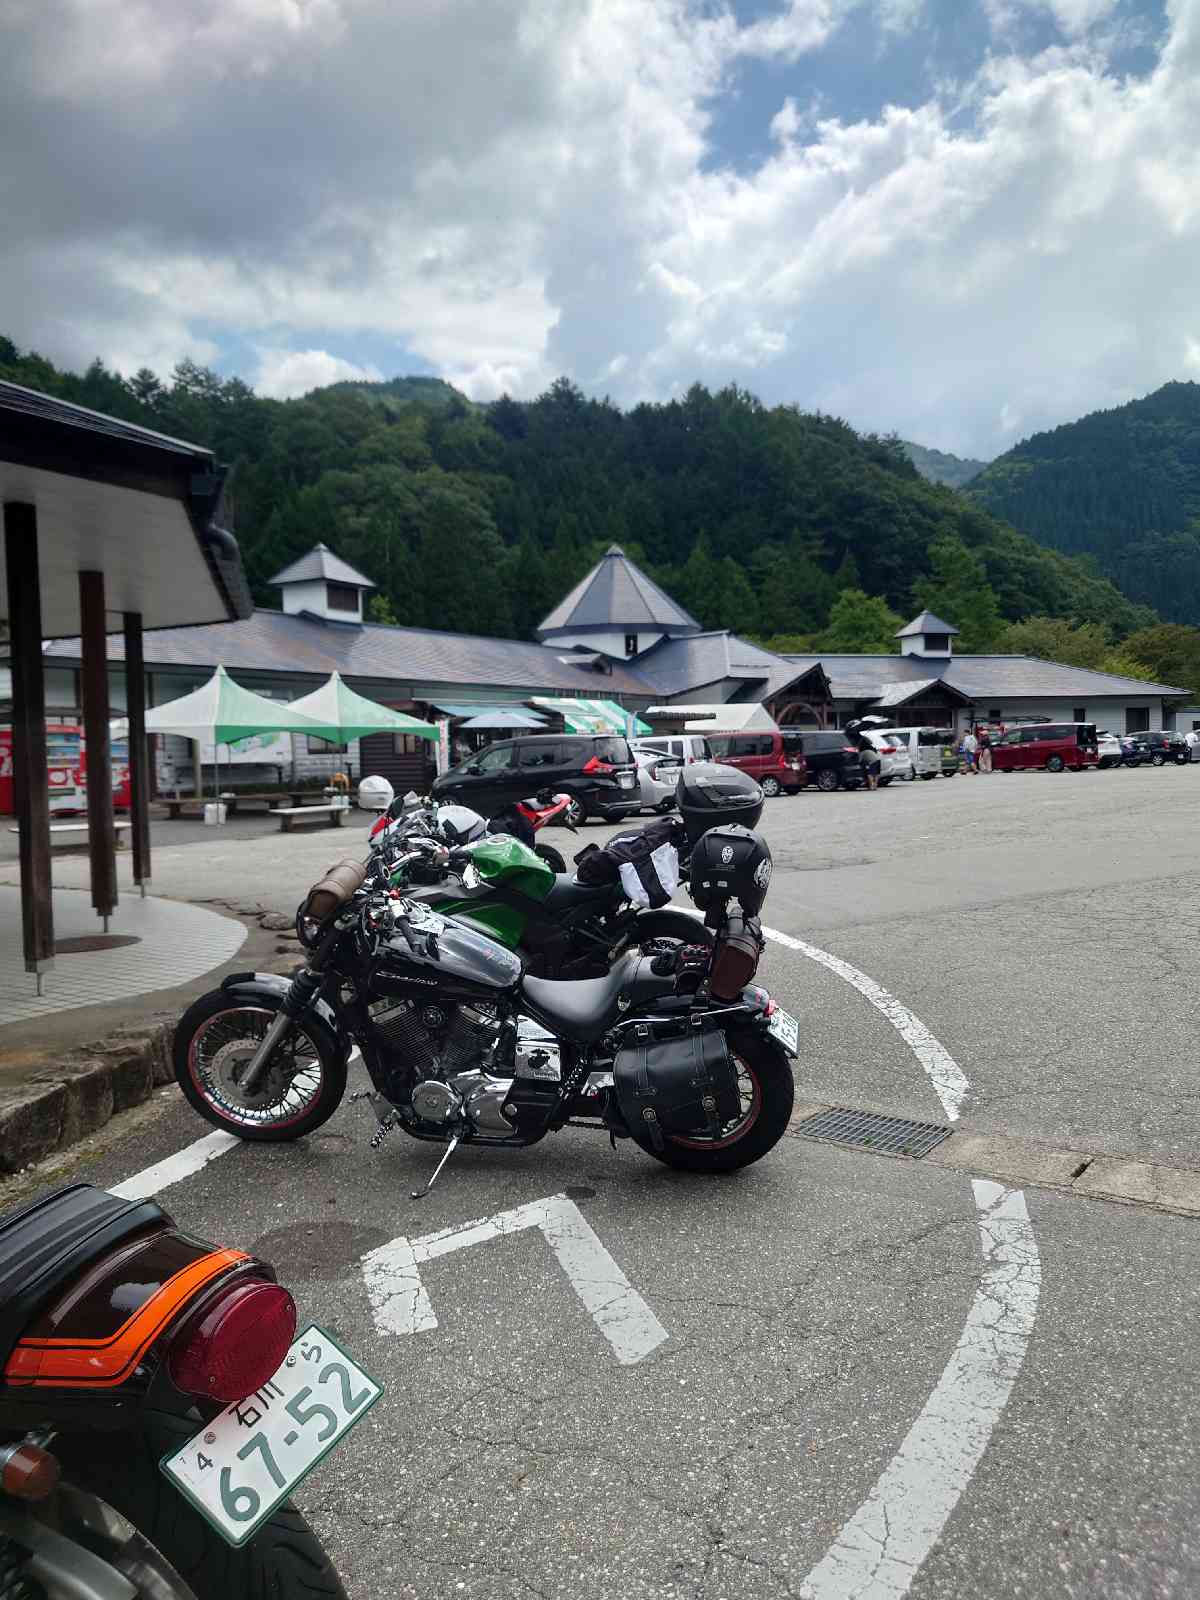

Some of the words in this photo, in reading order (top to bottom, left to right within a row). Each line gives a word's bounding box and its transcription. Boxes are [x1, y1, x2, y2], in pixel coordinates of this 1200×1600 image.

[228, 1381, 285, 1428] 石川
[300, 1341, 322, 1364] ら
[196, 1452, 214, 1470] 4
[220, 1362, 372, 1521] 67-52
